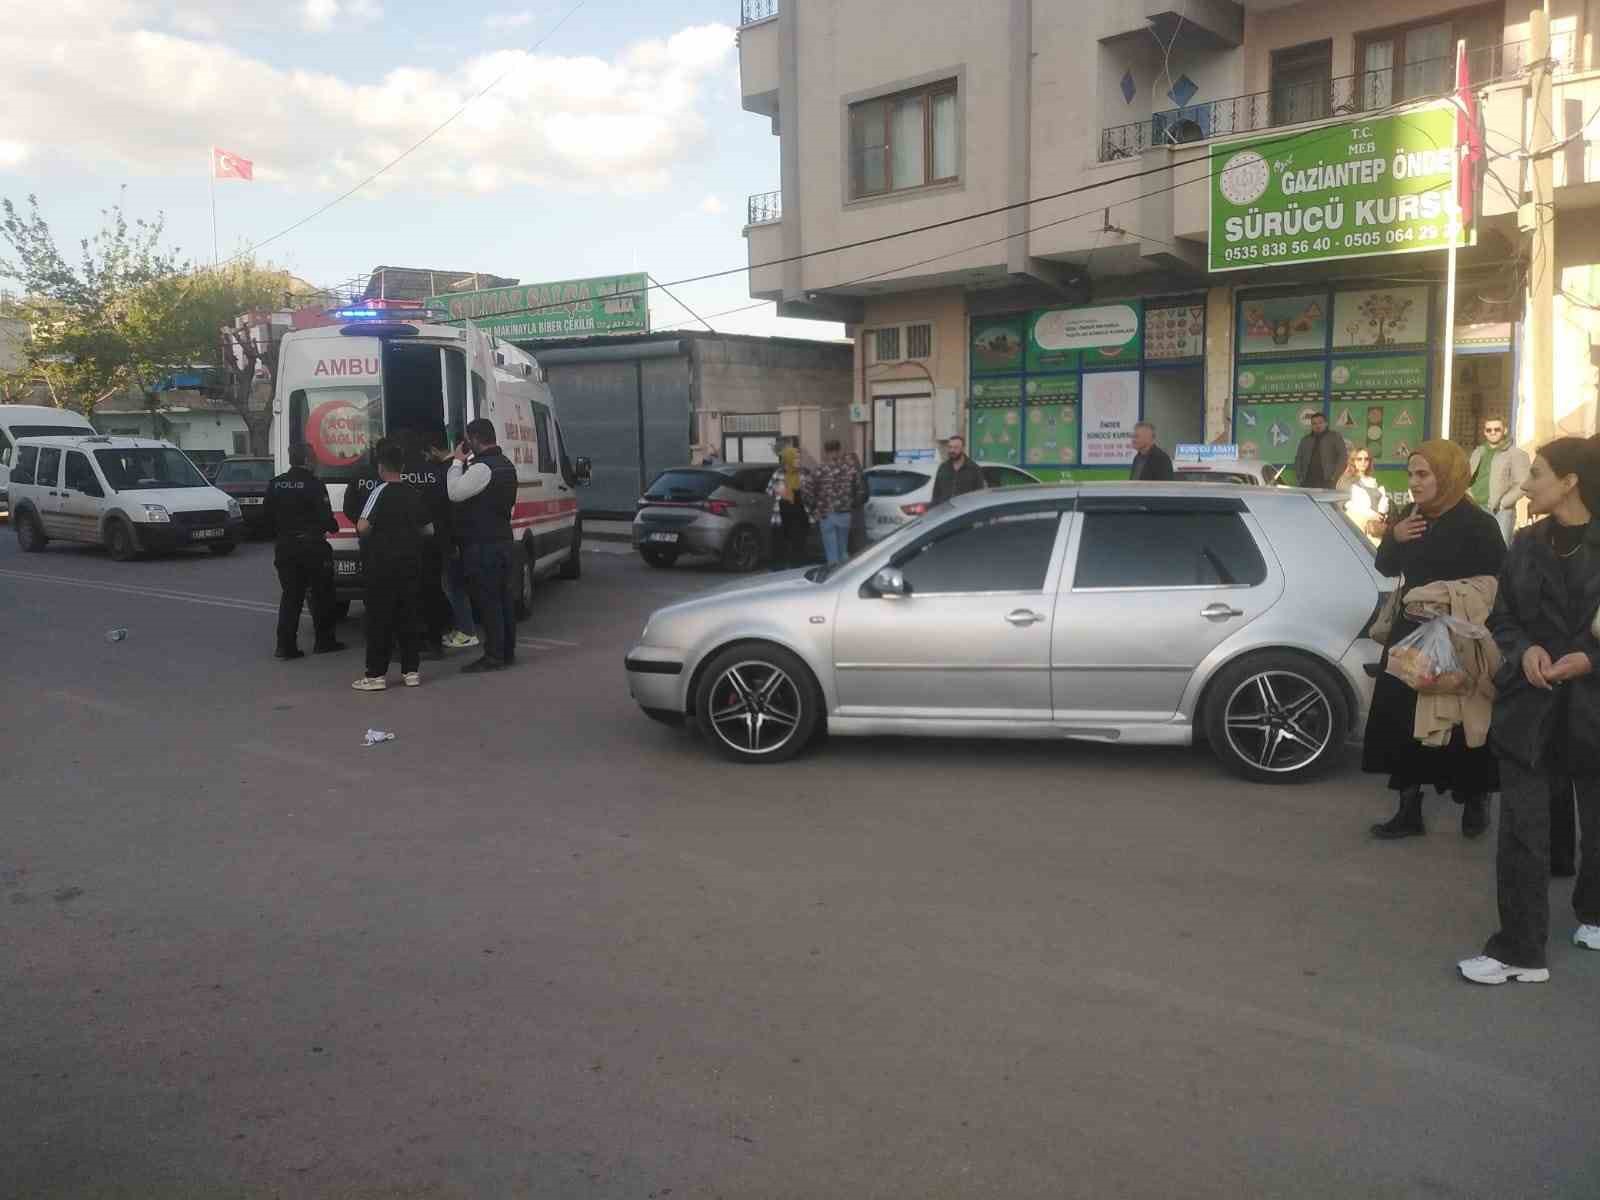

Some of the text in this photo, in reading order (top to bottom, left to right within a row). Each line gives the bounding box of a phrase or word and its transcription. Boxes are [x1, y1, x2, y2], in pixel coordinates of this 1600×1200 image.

[1351, 126, 1373, 140] T.C.
[1348, 142, 1376, 156] MEB
[1281, 147, 1455, 196] GAZİANTEP ÖNDE
[1224, 197, 1345, 242] SÜRÜCÜ
[1224, 245, 1258, 262] 0535
[1261, 242, 1287, 257] 838
[1291, 239, 1309, 254] 56
[1312, 237, 1331, 252] 40
[1344, 231, 1381, 248] 0505
[1386, 227, 1413, 244] 064
[314, 358, 379, 377] AMBU
